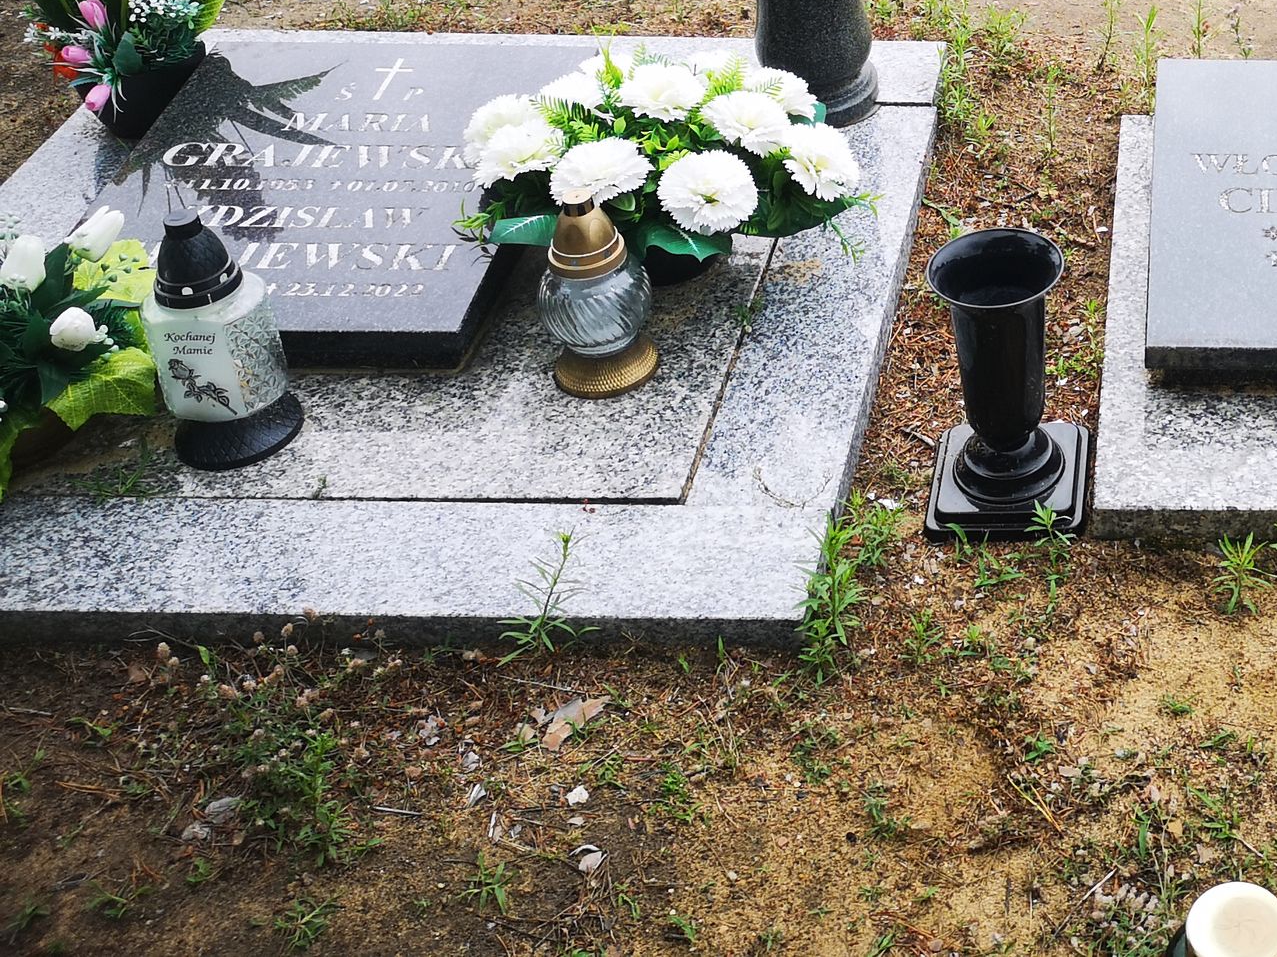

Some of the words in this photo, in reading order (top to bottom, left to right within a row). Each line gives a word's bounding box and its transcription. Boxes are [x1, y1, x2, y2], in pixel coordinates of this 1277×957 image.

[281, 112, 433, 133] MARIA
[162, 142, 476, 170] GRAJEWSK
[164, 331, 216, 345] Kochanej
[173, 345, 213, 356] Mamie
